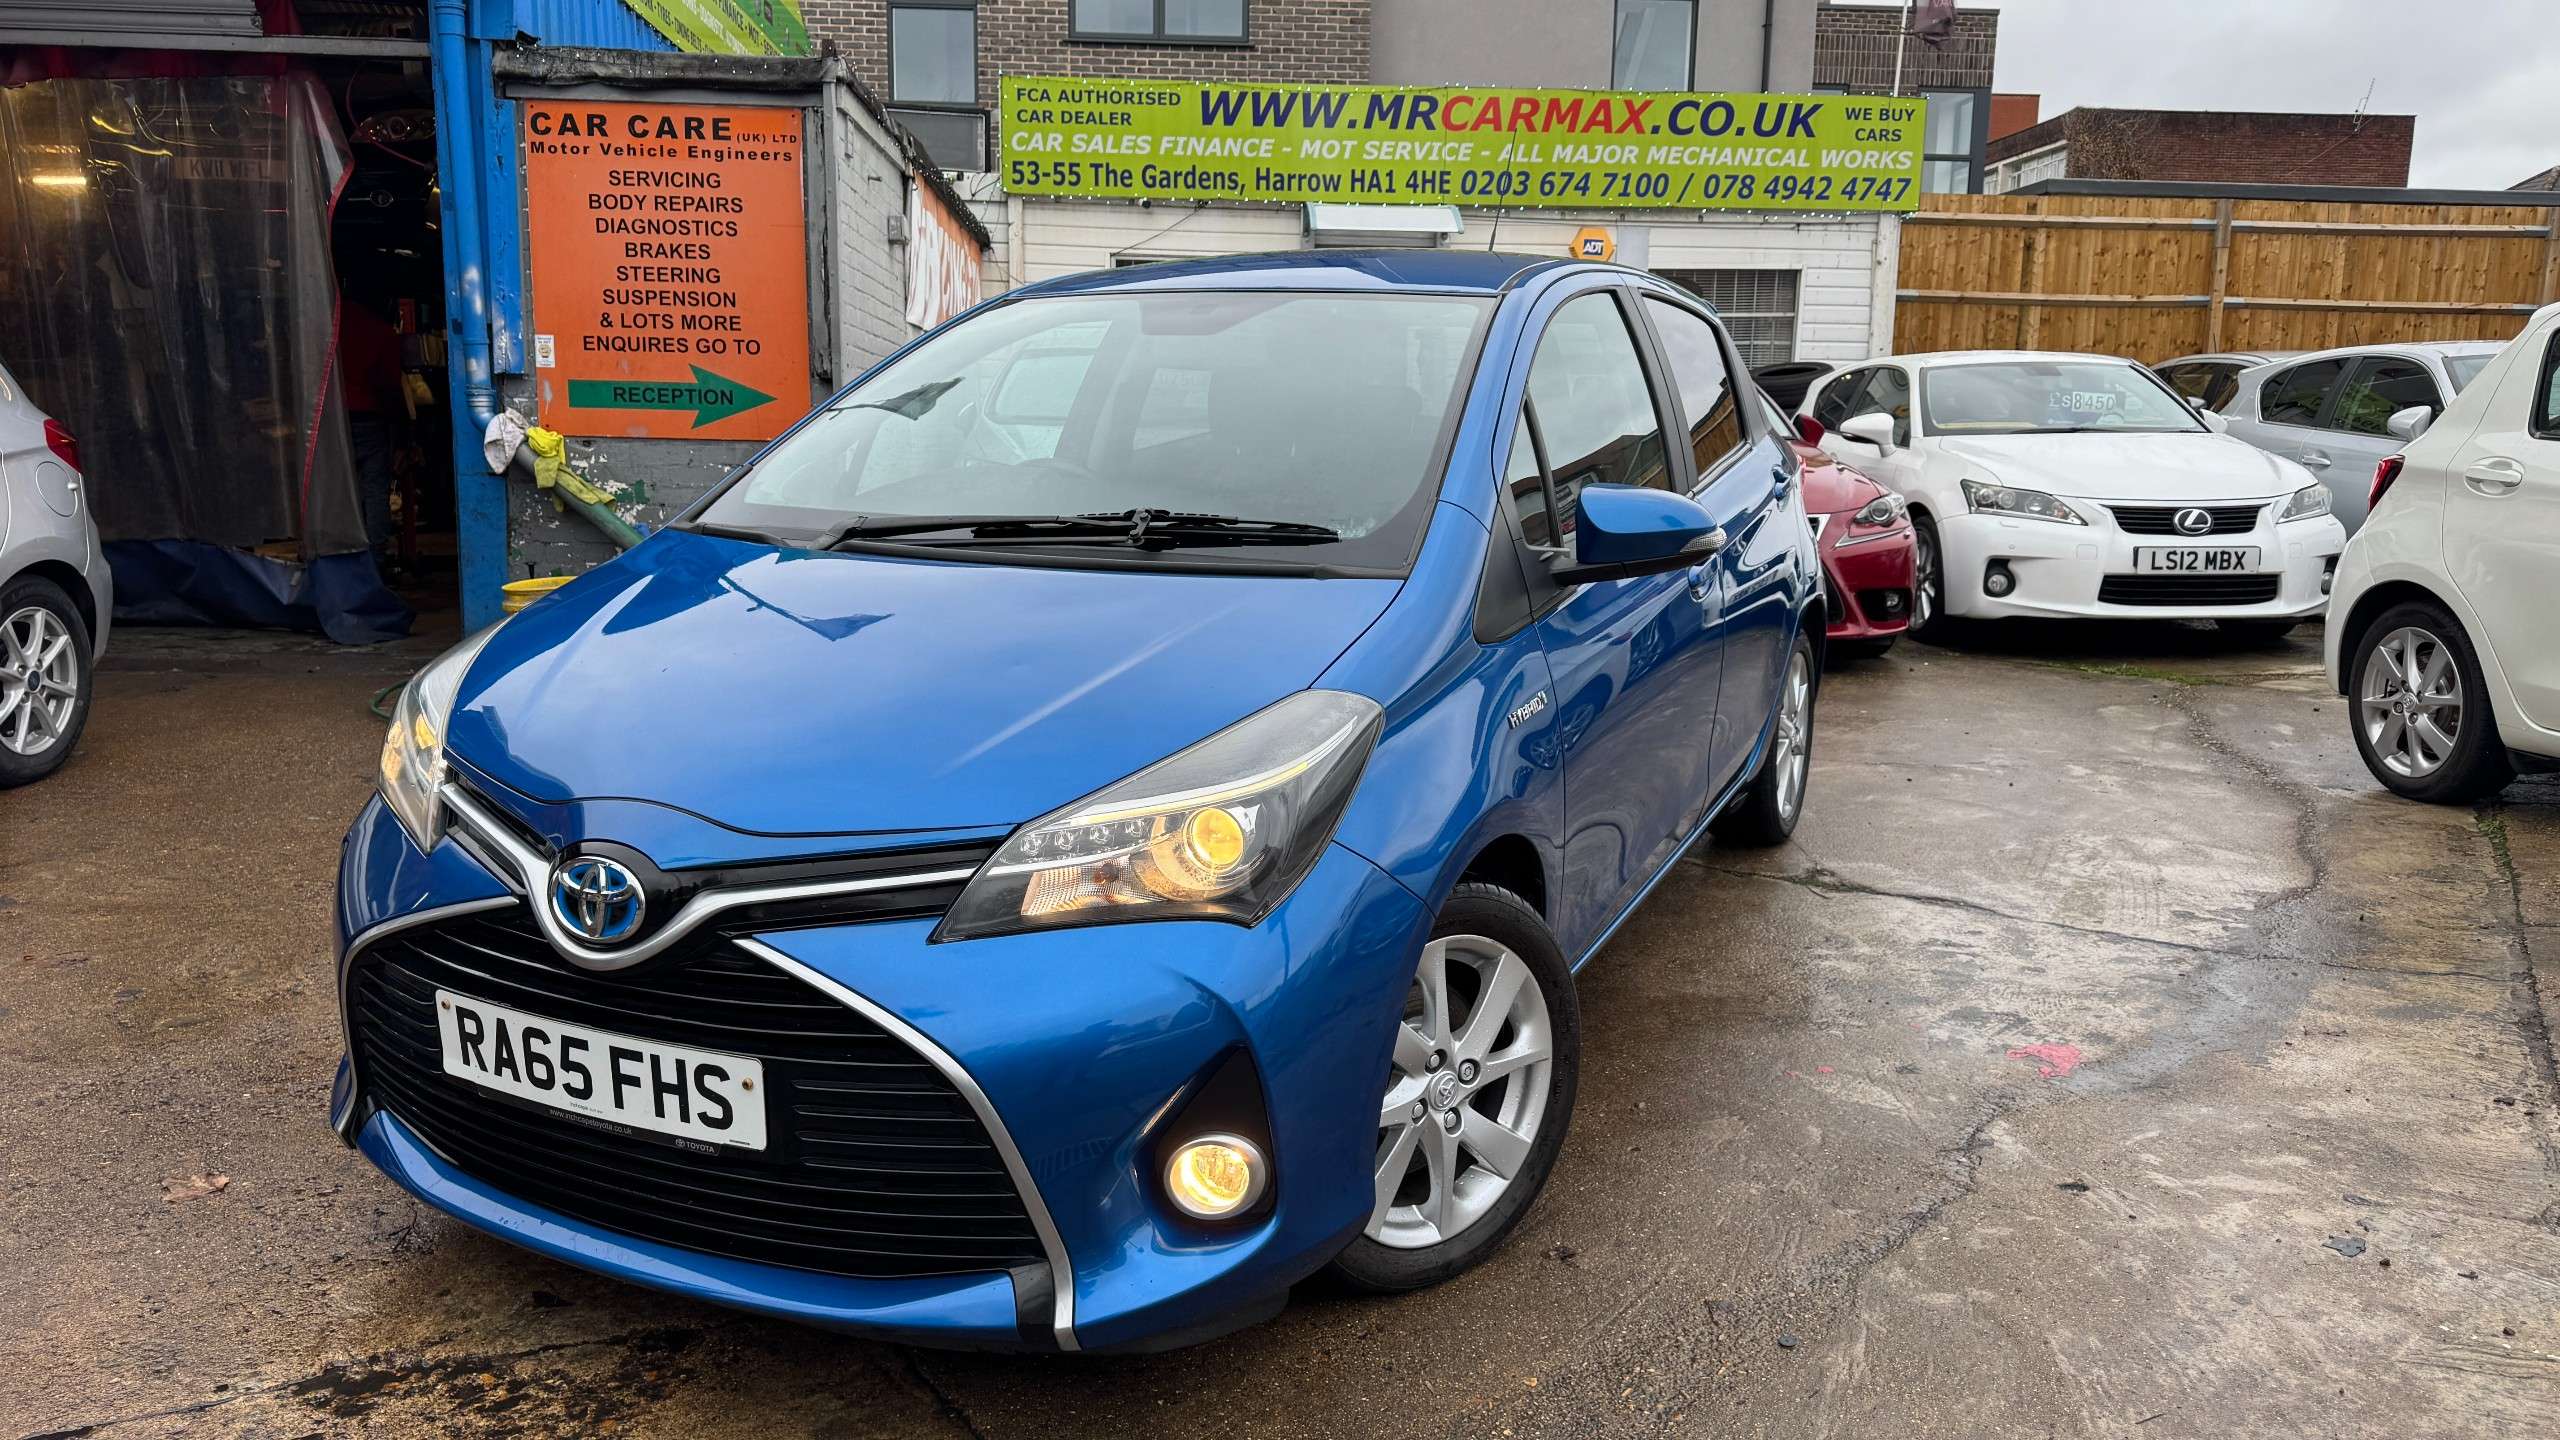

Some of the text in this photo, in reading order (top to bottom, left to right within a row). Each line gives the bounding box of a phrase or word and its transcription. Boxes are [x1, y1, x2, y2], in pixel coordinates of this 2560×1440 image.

[1016, 88, 1181, 106] FCA AUTHORISED
[1016, 109, 1132, 126] CAR DEALER
[1200, 90, 1823, 138] WWW.MRCARMAX.CO.UK
[1845, 107, 1916, 122] WE BUY
[530, 112, 797, 145] CAR CARE (UK) LTD
[1855, 127, 1902, 142] CARS
[530, 141, 793, 162] Motor Vehicle Engineers
[1011, 132, 1065, 153] CAR
[1071, 133, 1152, 155] SALES
[1159, 136, 1275, 158] FINANCE
[1300, 139, 1354, 160] MOT
[1363, 140, 1472, 162] SERVICE
[1498, 144, 1543, 164] ALL
[1552, 145, 1637, 166] MAJOR
[1647, 146, 1811, 169] MECHANICAL
[1820, 149, 1913, 171] WORKS
[608, 170, 721, 189] SERVICING
[1011, 161, 1911, 203] 53-55 The Gardens, Harrow HA1 4HE 0203 674 7100 / 078 4942 4747
[588, 194, 743, 213] BODY REPAIRS
[595, 217, 738, 237] DIAGNOSTICS
[625, 242, 711, 260] BRAKES
[1583, 241, 1603, 254] ADT
[616, 266, 721, 284] STEERING
[602, 289, 736, 308] SUSPENSION
[600, 313, 741, 331] & LOTS MORE
[583, 335, 761, 355] ENQUIRES GO TO
[613, 387, 734, 406] RECEPTION
[2151, 551, 2246, 571] LS12 MBX
[1508, 697, 1544, 729] HYBRID
[455, 1005, 734, 1131] RA65 FHS
[686, 1141, 715, 1154] TOYOTA
